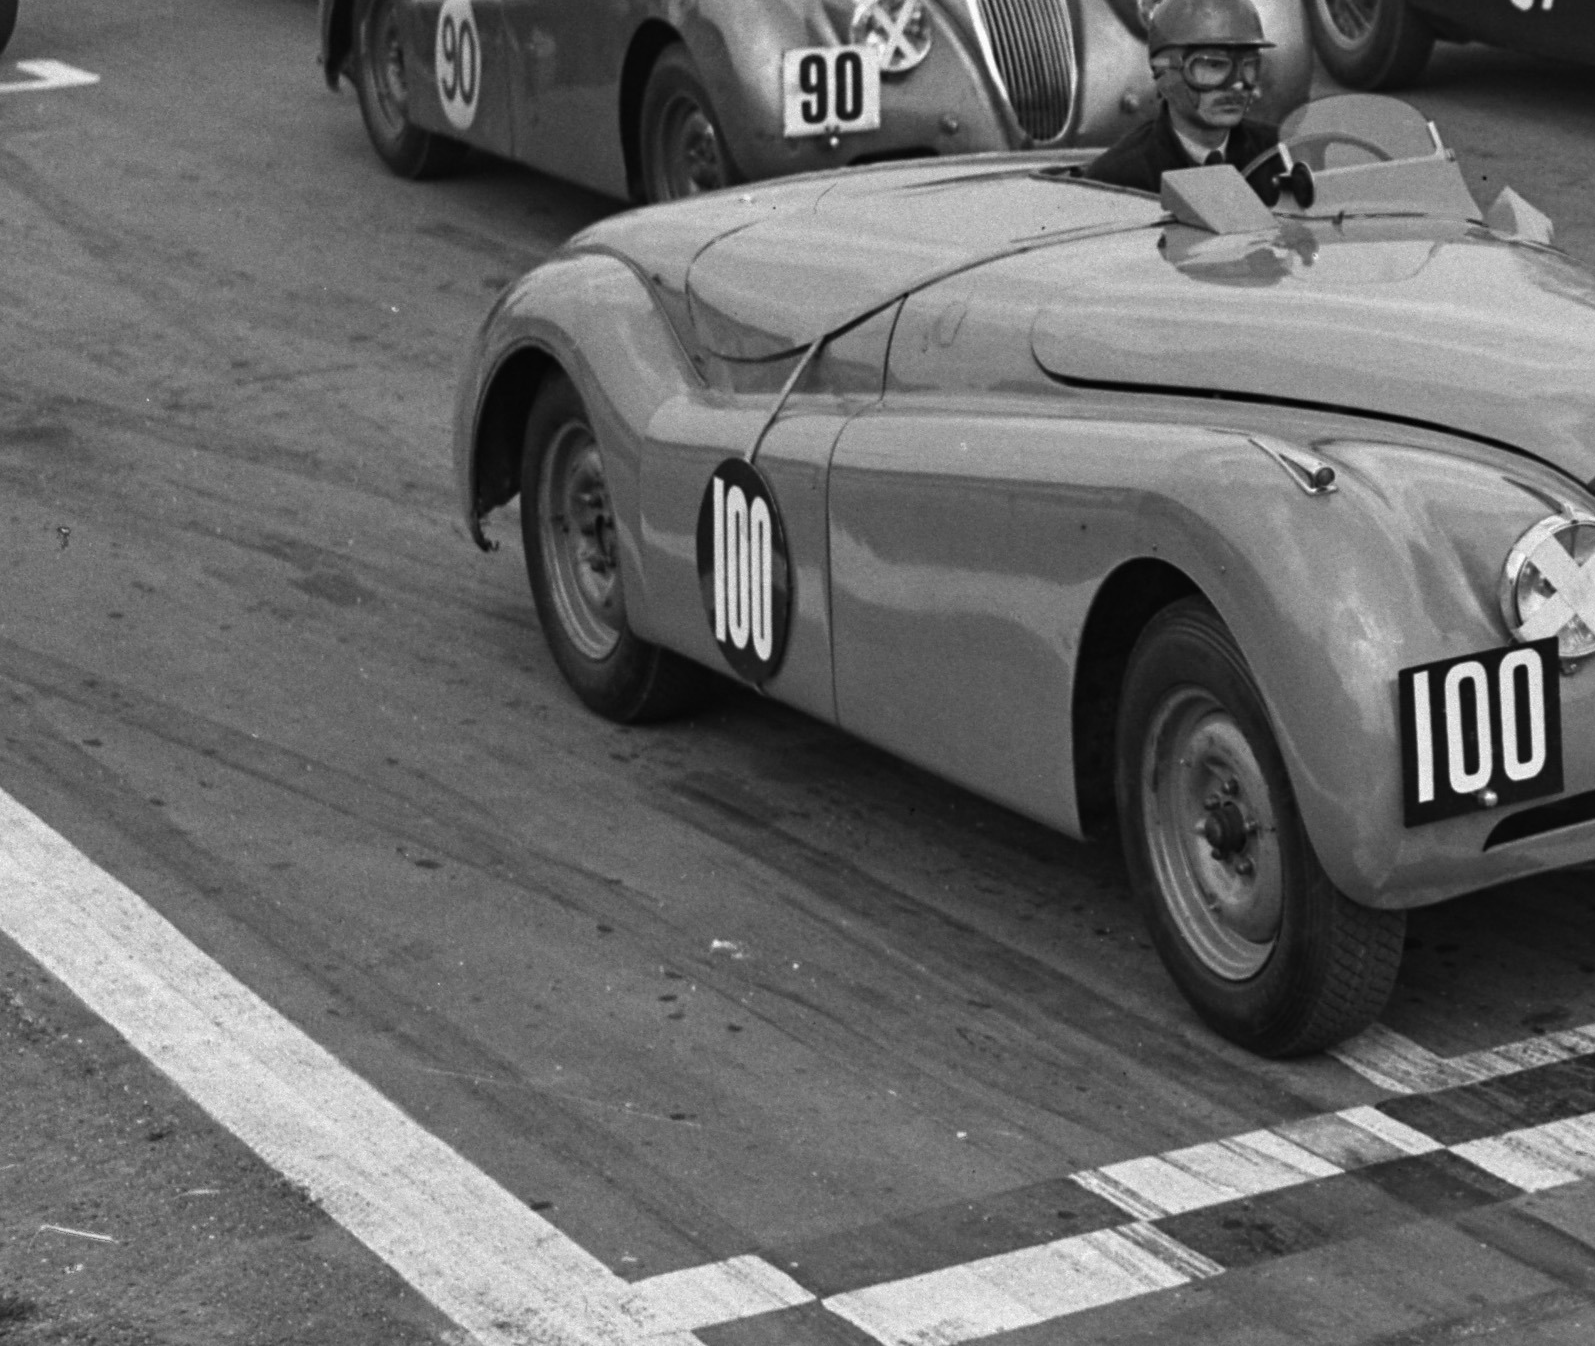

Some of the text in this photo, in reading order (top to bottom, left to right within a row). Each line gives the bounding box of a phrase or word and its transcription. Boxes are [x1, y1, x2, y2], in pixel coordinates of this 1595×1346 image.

[440, 13, 480, 105] 90
[800, 51, 865, 126] 90
[713, 475, 773, 663] 100
[1412, 647, 1547, 803] 100
